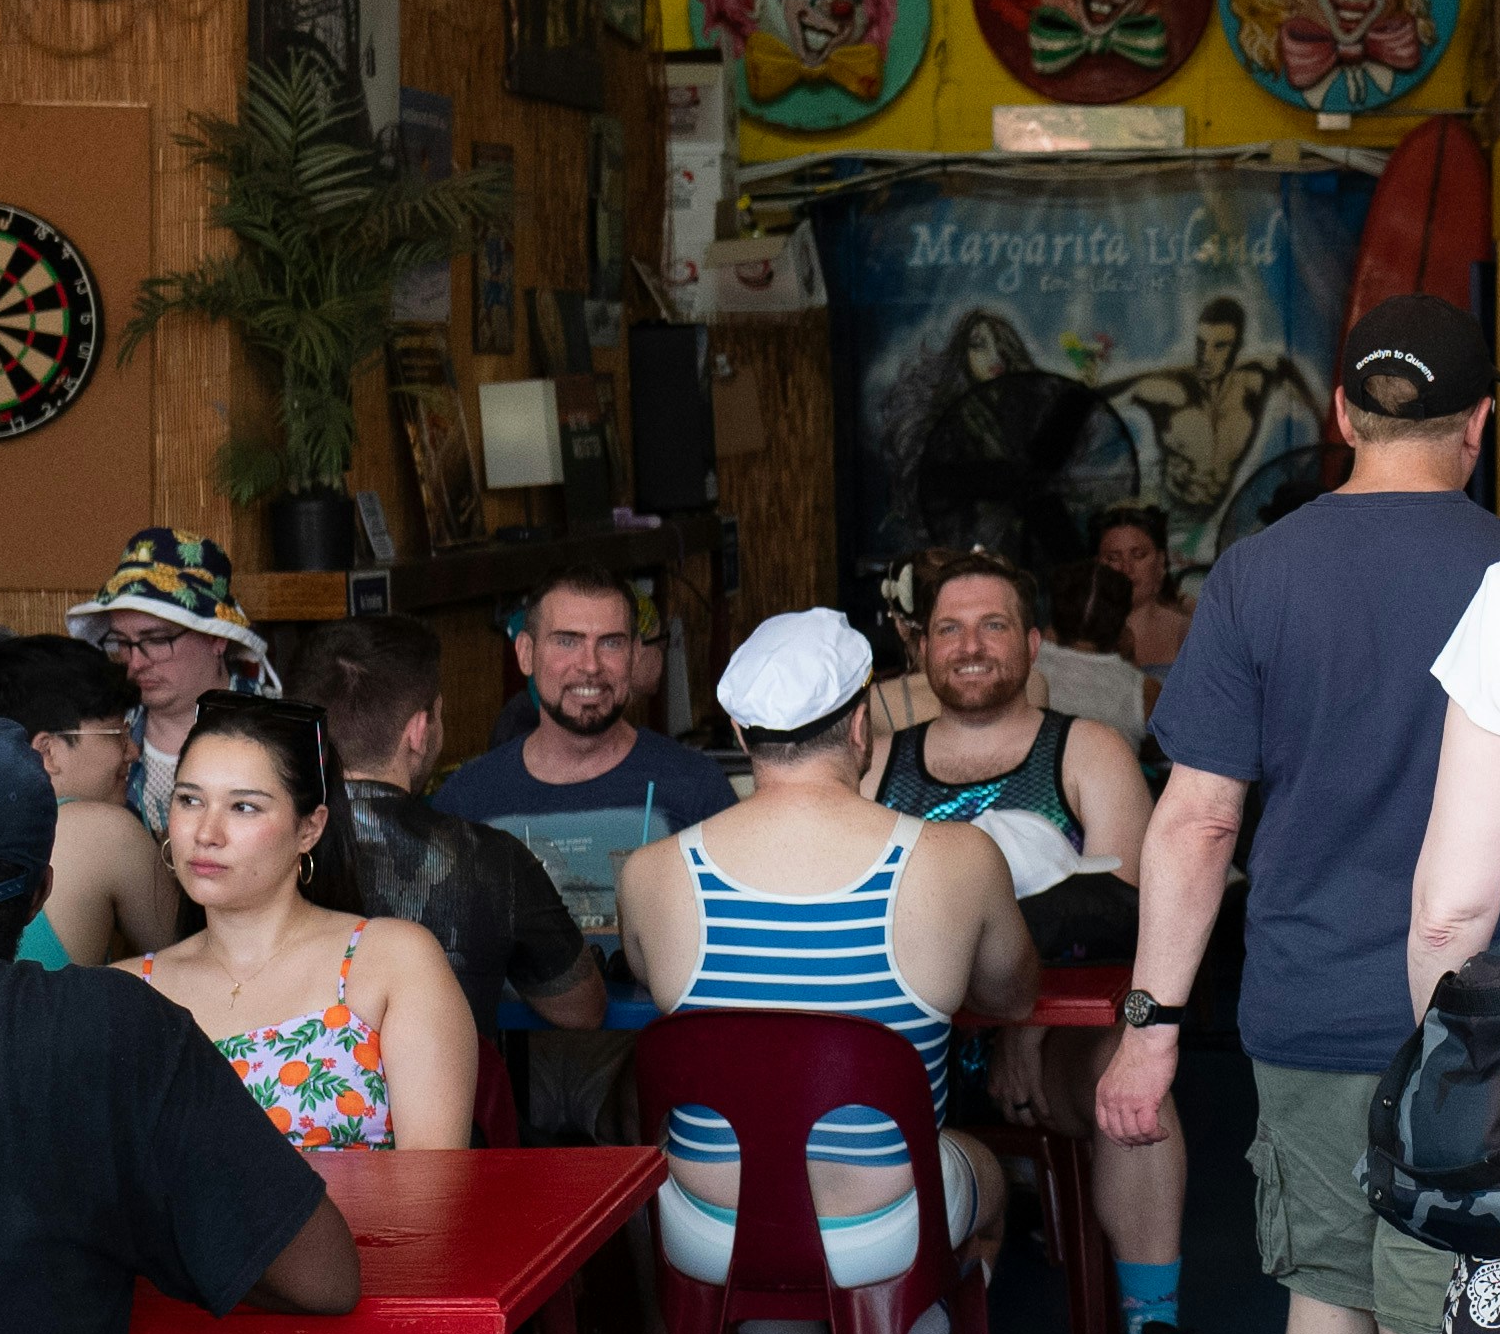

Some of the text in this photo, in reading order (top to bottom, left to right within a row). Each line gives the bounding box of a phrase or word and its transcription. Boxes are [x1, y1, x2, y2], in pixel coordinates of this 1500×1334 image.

[909, 207, 1285, 292] Margarita Island
[1394, 349, 1435, 383] to Queens
